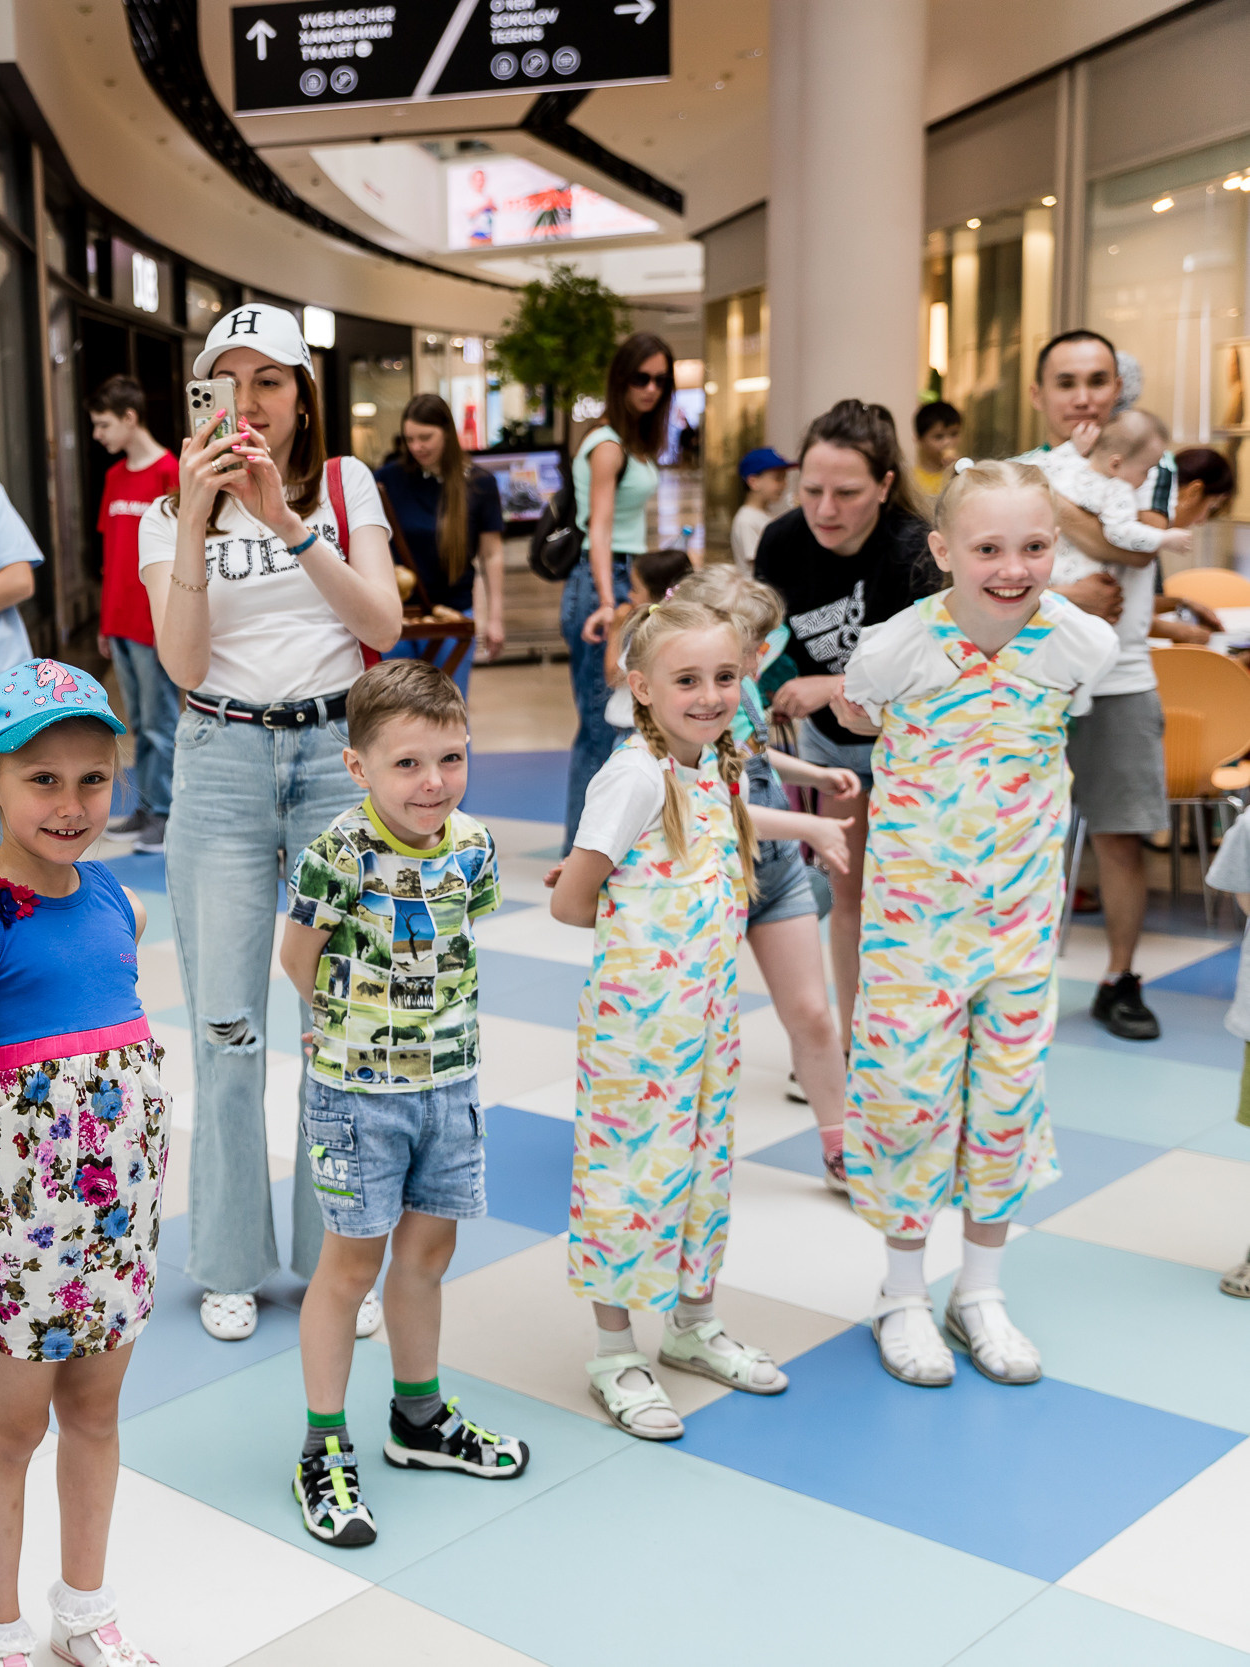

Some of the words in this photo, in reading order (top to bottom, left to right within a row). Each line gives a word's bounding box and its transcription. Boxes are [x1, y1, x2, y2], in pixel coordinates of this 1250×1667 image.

[299, 11, 335, 29] YVES
[335, 5, 396, 25] ROCHER
[490, 7, 559, 28] SOKOLOV
[490, 26, 545, 44] TEZENIS
[227, 310, 262, 338] H
